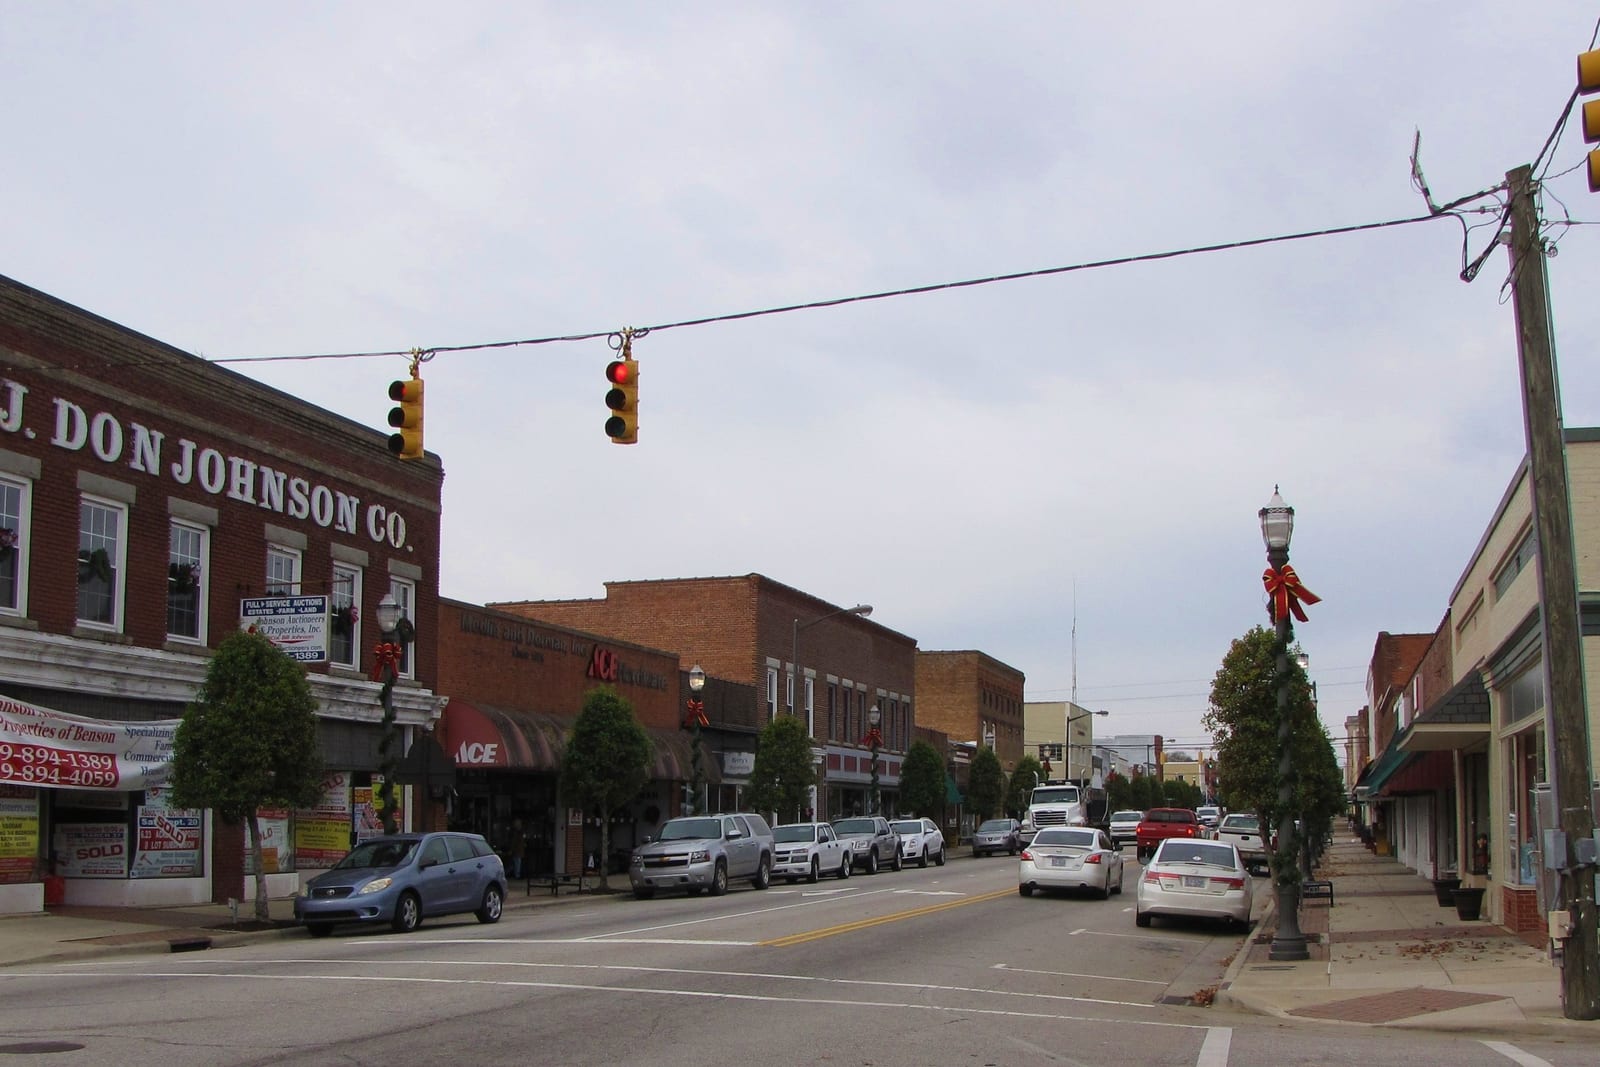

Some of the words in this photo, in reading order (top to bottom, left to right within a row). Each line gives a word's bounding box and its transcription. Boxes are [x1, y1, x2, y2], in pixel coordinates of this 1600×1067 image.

[0, 377, 37, 439] J.
[50, 397, 165, 476] DON
[171, 438, 361, 535] JOHNSON
[366, 503, 414, 552] CO.
[293, 598, 322, 606] AUCTIONS
[286, 615, 325, 624] Auctioneers
[309, 624, 322, 632] Inc.
[503, 625, 523, 642] and
[587, 643, 618, 681] ACE
[58, 724, 75, 740] of
[73, 726, 116, 744] Benson
[455, 740, 498, 763] ACE
[0, 762, 116, 786] 9-894-4059
[318, 772, 345, 794] OLD
[156, 815, 184, 844] SOLD
[77, 844, 123, 860] SOLD
